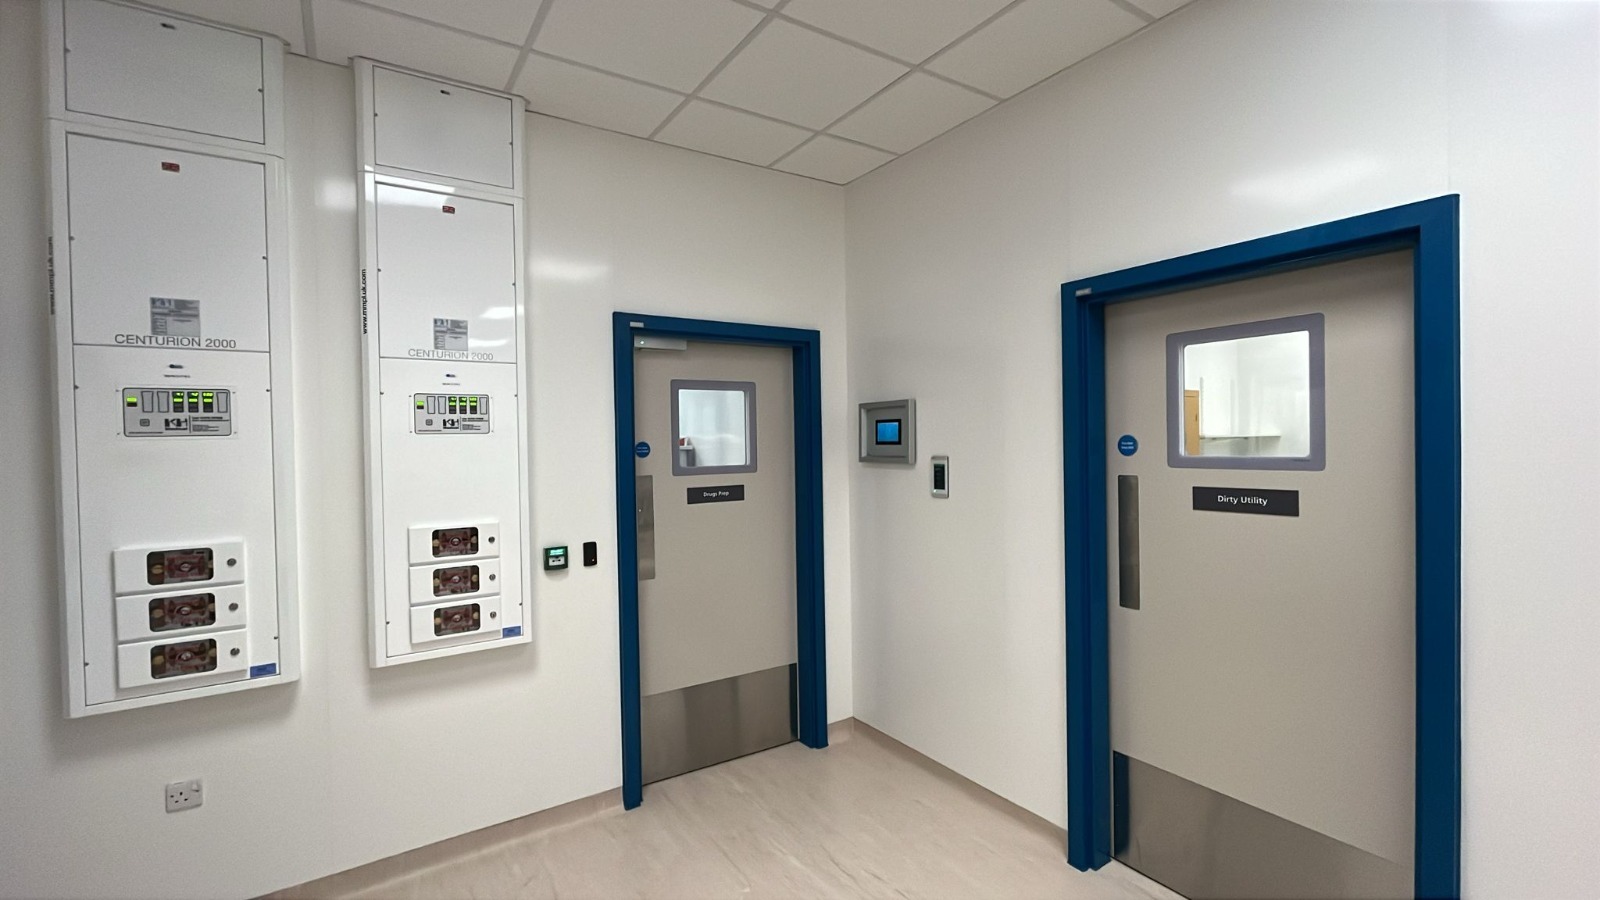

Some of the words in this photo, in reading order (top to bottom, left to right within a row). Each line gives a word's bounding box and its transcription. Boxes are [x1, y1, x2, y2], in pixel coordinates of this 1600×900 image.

[114, 333, 202, 348] CENTURION
[205, 338, 237, 349] 2000
[408, 348, 469, 360] CENTURION
[471, 352, 494, 361] 2000
[1217, 495, 1239, 505] Dirty
[1240, 496, 1268, 507] Utility
